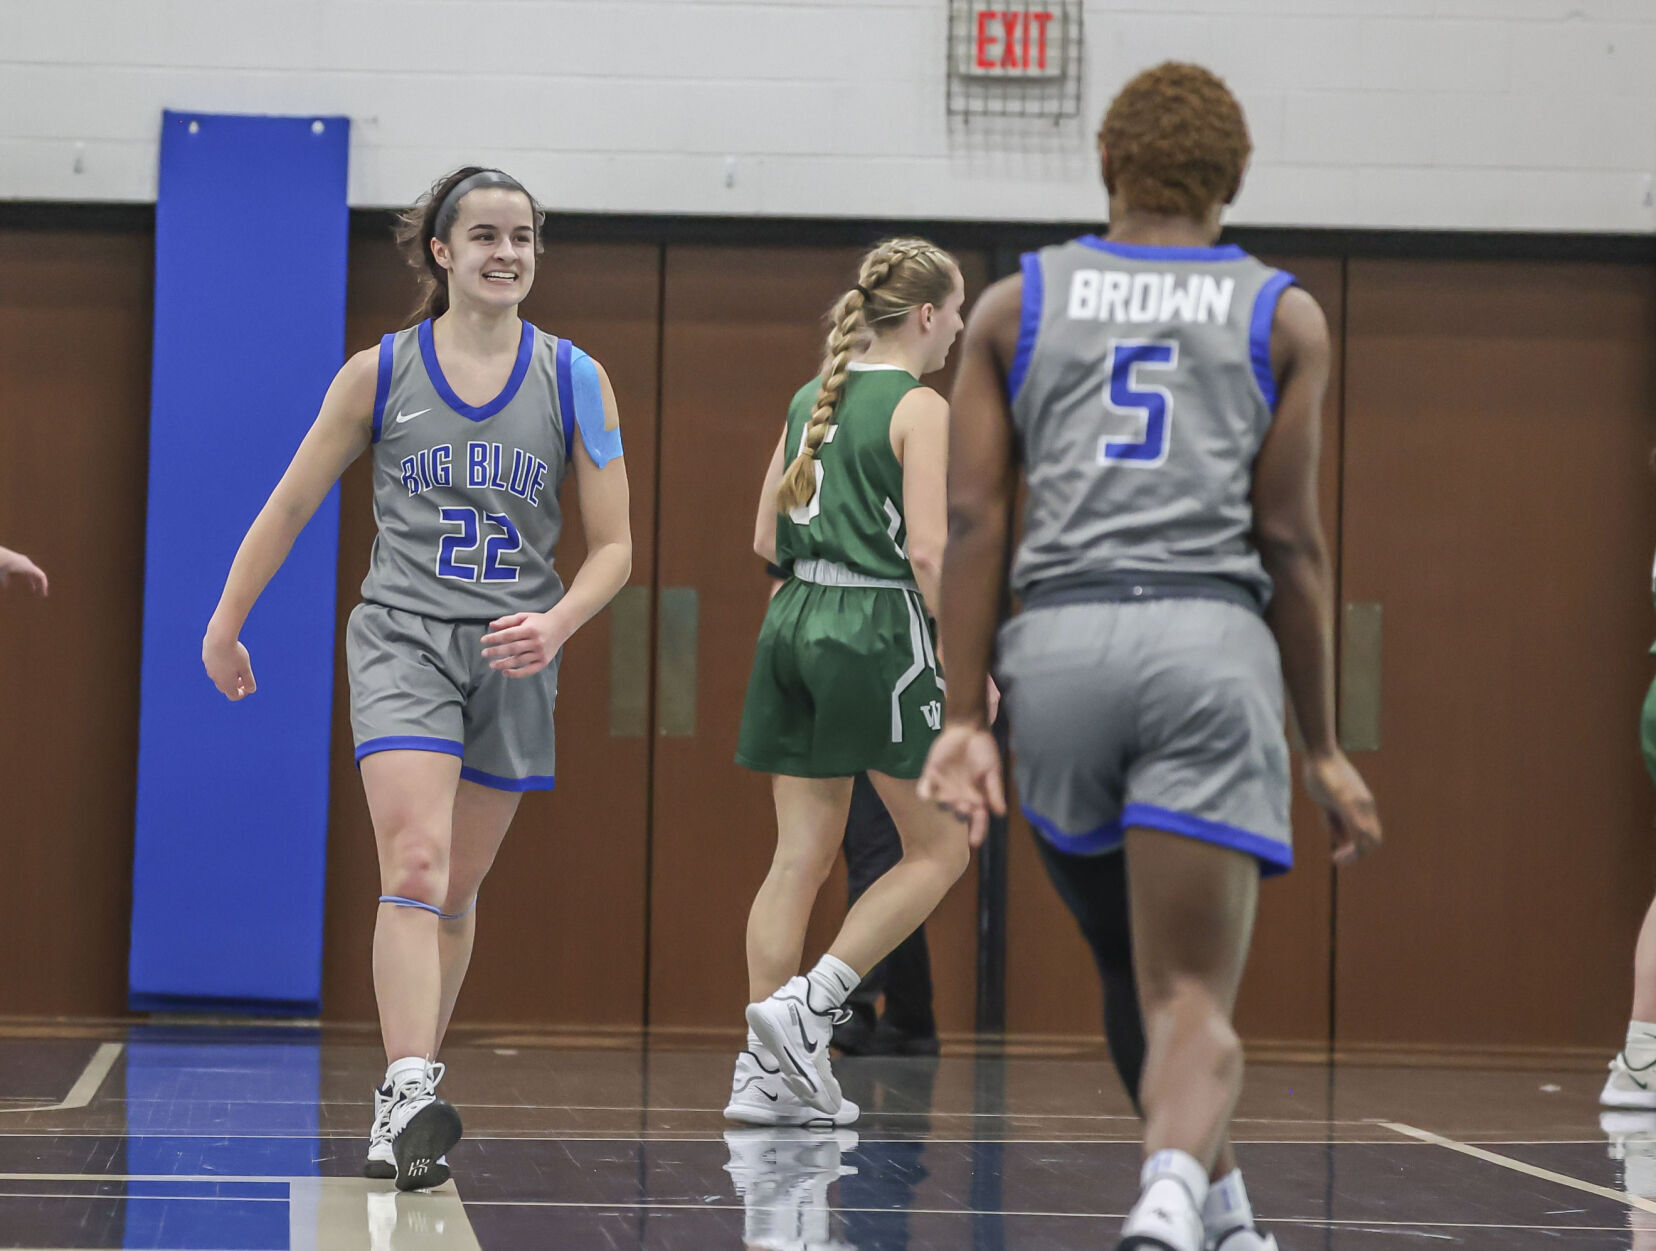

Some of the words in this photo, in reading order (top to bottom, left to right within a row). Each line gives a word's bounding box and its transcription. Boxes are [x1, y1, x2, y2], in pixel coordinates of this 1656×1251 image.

[976, 10, 1053, 70] EXIT
[1067, 269, 1235, 325] BROWN
[1096, 338, 1179, 469] 5
[400, 444, 452, 497] BIG
[466, 441, 547, 507] BLUE
[436, 506, 522, 583] 22
